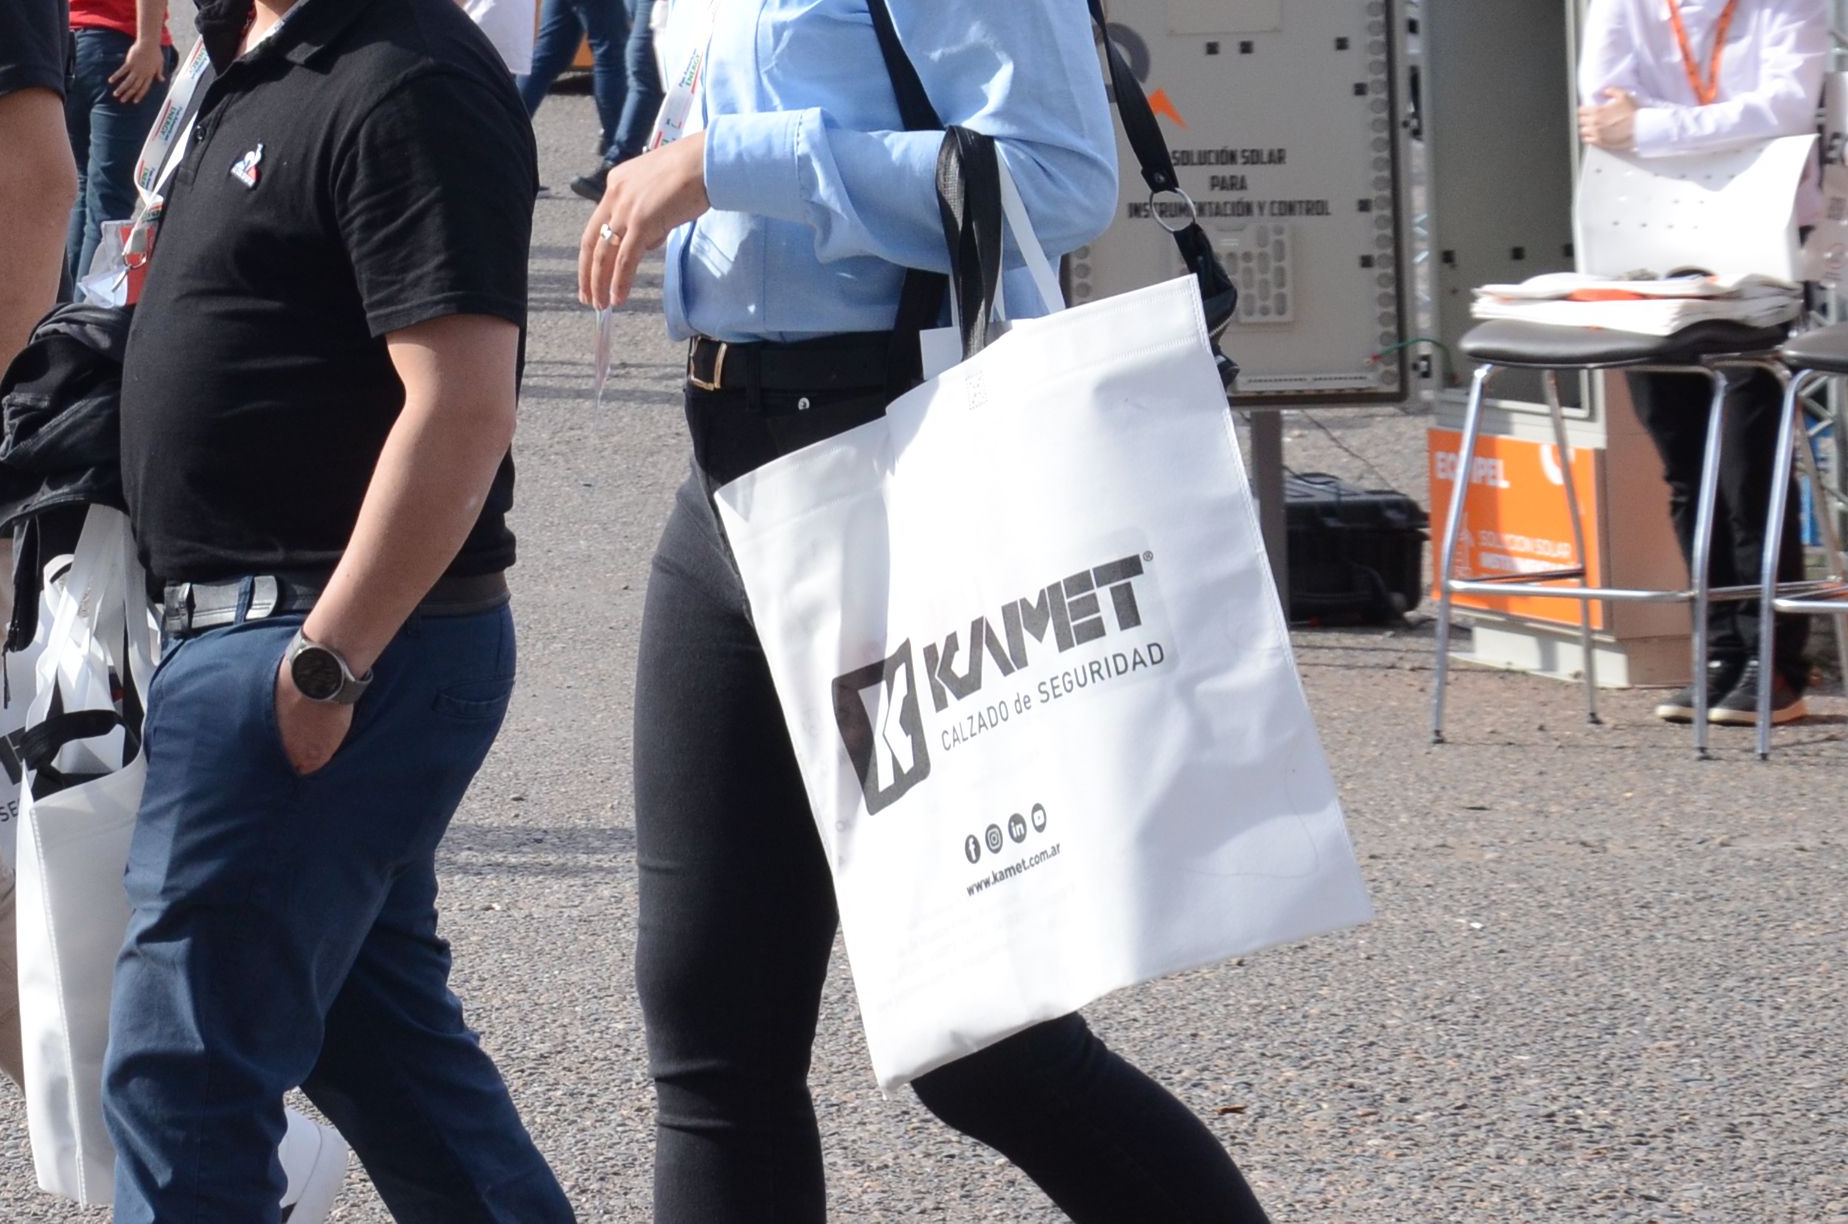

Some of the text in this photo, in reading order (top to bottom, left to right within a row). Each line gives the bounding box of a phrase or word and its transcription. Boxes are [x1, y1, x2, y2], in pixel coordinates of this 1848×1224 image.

[1171, 146, 1287, 166] SOLUCIÓN SOLAR
[1209, 174, 1248, 192] PARA
[1257, 200, 1268, 217] Y
[1270, 199, 1332, 217] CONTROL
[940, 642, 1166, 752] CALZADO de SEGURIDAD
[965, 841, 1062, 898] www.kamet.com.ar
